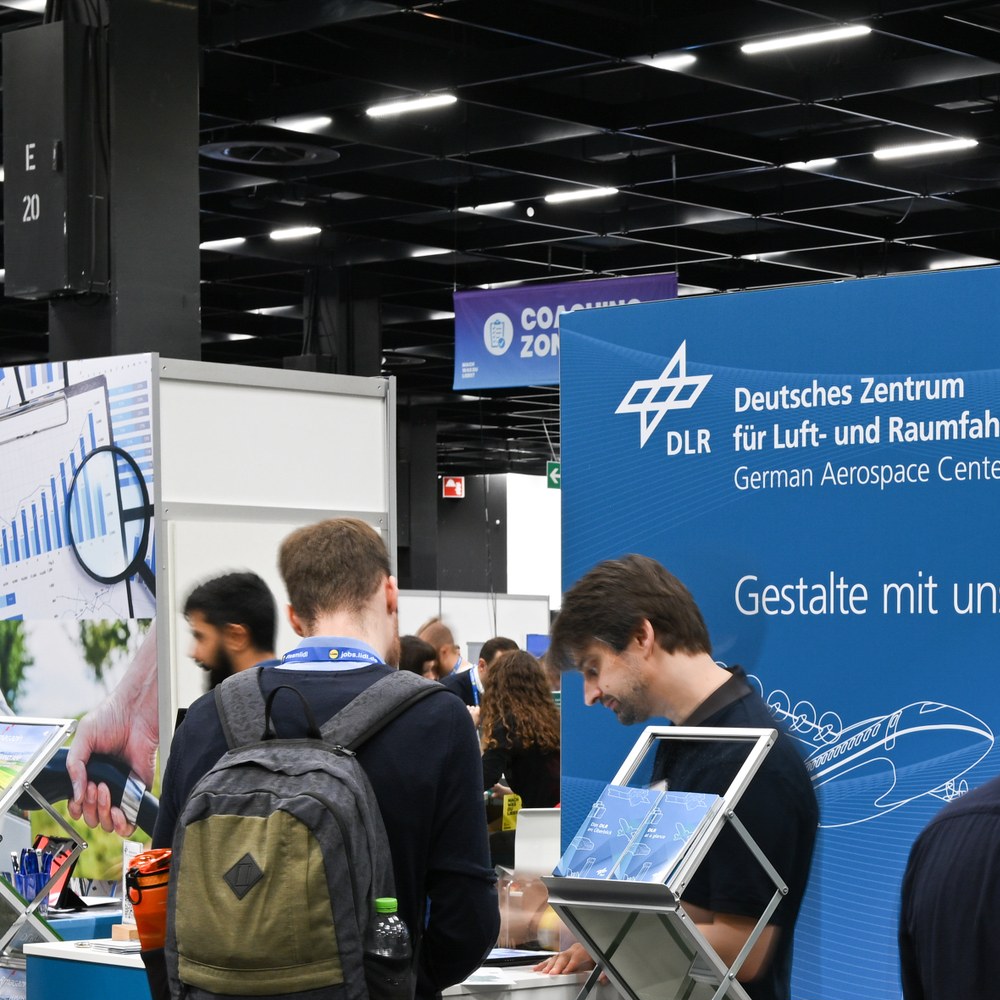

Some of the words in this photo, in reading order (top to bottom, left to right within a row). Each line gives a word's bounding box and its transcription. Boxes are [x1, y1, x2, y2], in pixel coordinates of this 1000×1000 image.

[26, 143, 36, 171] E
[23, 194, 40, 222] 20
[735, 380, 852, 412] Deutsches
[860, 377, 965, 403] Zentrum
[667, 429, 711, 456] DLR
[733, 424, 767, 451] für
[774, 420, 827, 449] Luft-
[834, 416, 880, 446] und
[733, 466, 813, 490] German
[821, 462, 930, 491] Aerospace
[735, 571, 868, 615] Gestalte
[883, 571, 939, 615] mit
